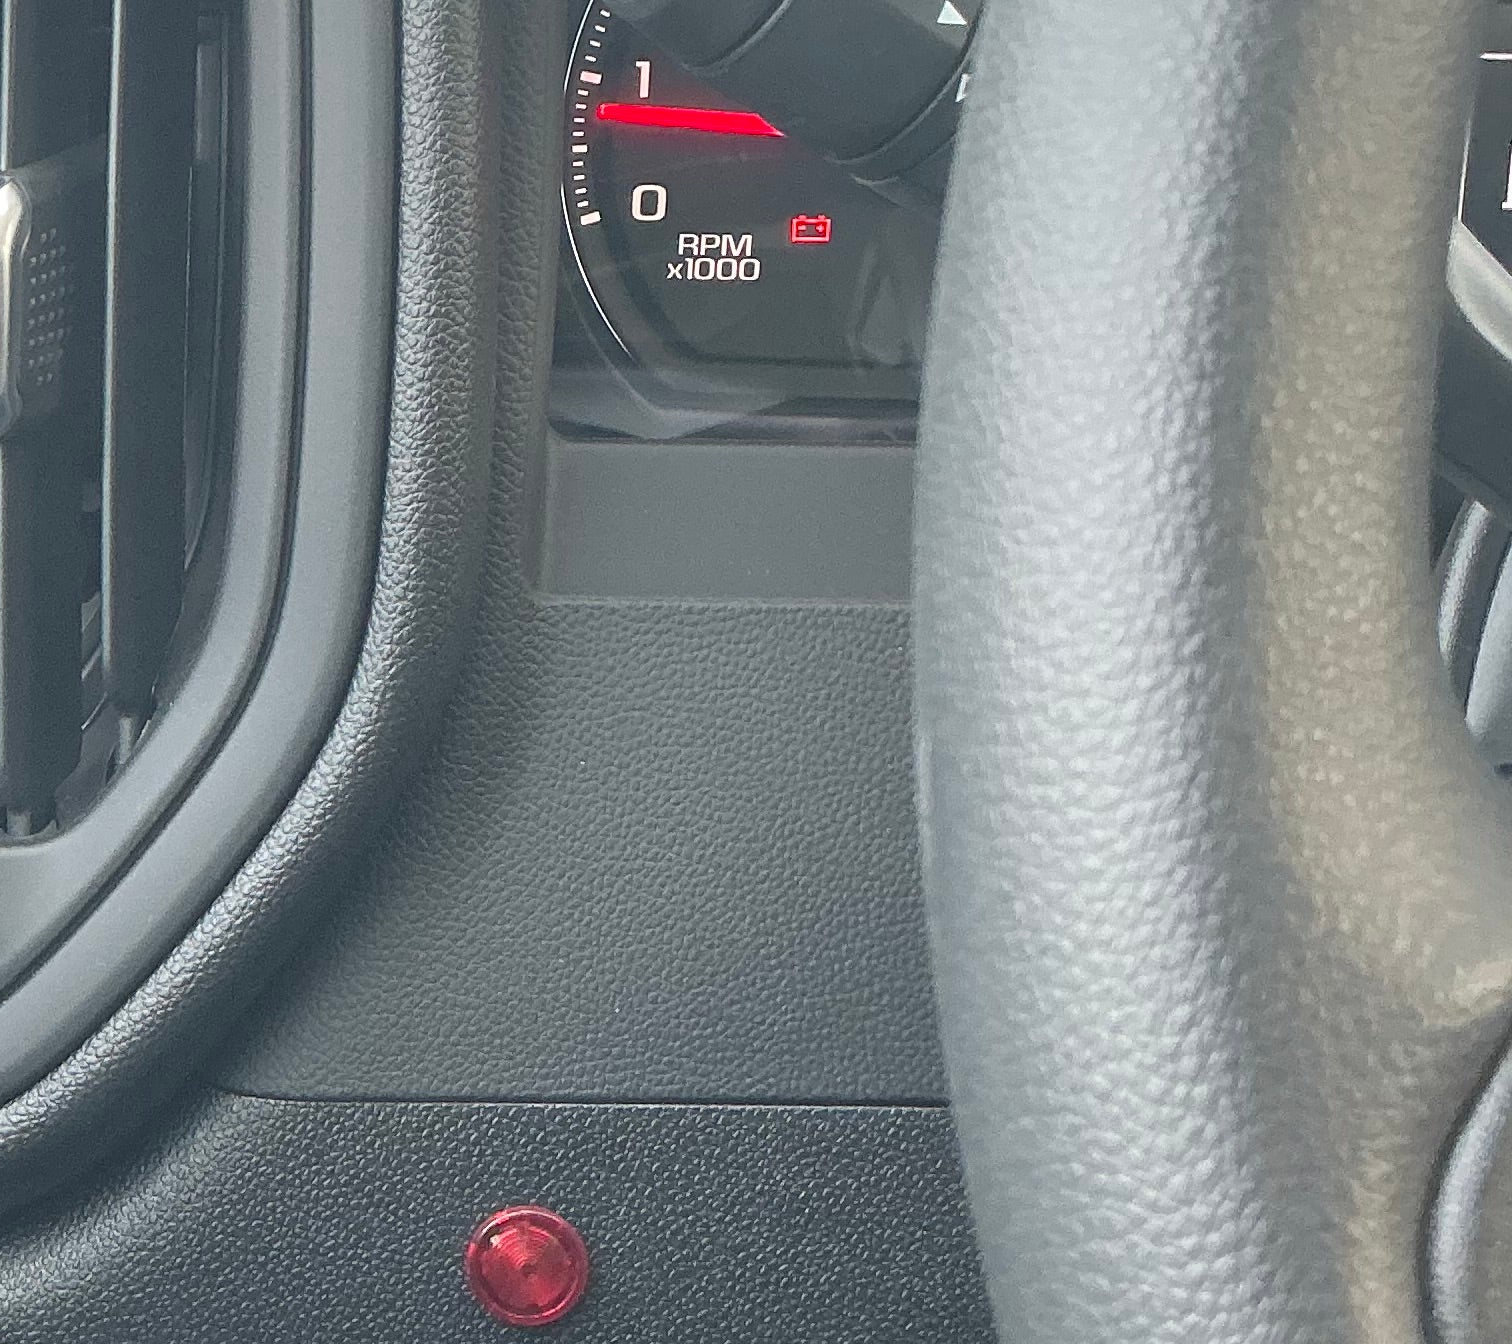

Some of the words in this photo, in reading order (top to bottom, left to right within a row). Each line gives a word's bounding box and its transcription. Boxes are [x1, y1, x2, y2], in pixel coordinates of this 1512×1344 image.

[635, 60, 651, 99] 1
[631, 184, 667, 221] 0
[678, 233, 753, 256] RPM
[666, 257, 761, 281] x1000
